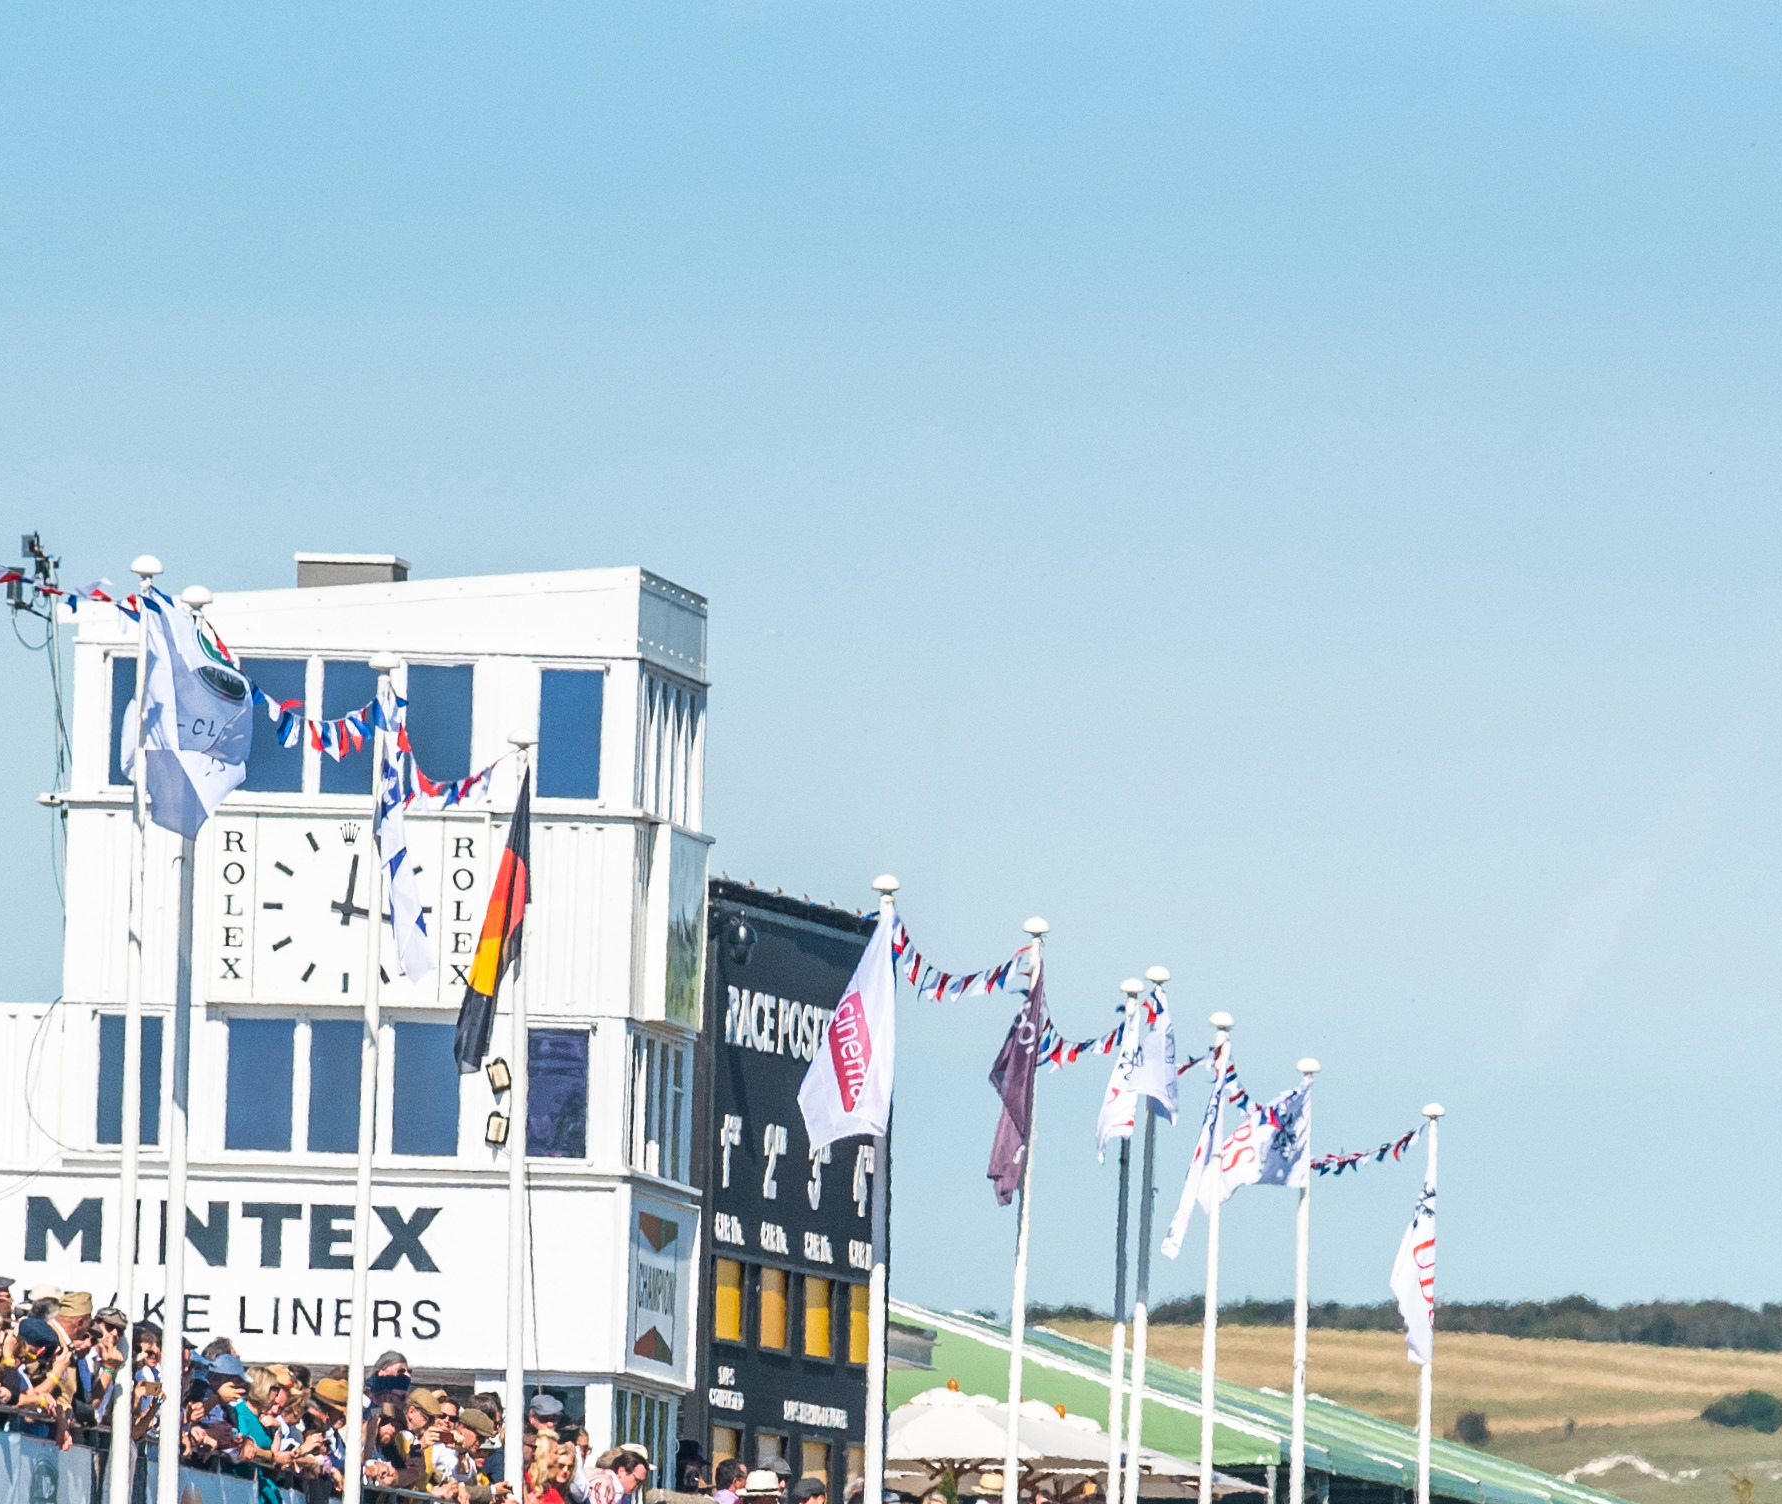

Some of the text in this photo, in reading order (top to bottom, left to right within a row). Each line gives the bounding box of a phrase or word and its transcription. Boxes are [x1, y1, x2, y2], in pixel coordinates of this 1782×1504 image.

[220, 830, 247, 980] ROLEX
[449, 837, 475, 985] ROLEX
[725, 985, 776, 1053] RACE
[239, 1296, 441, 1339] LINERS
